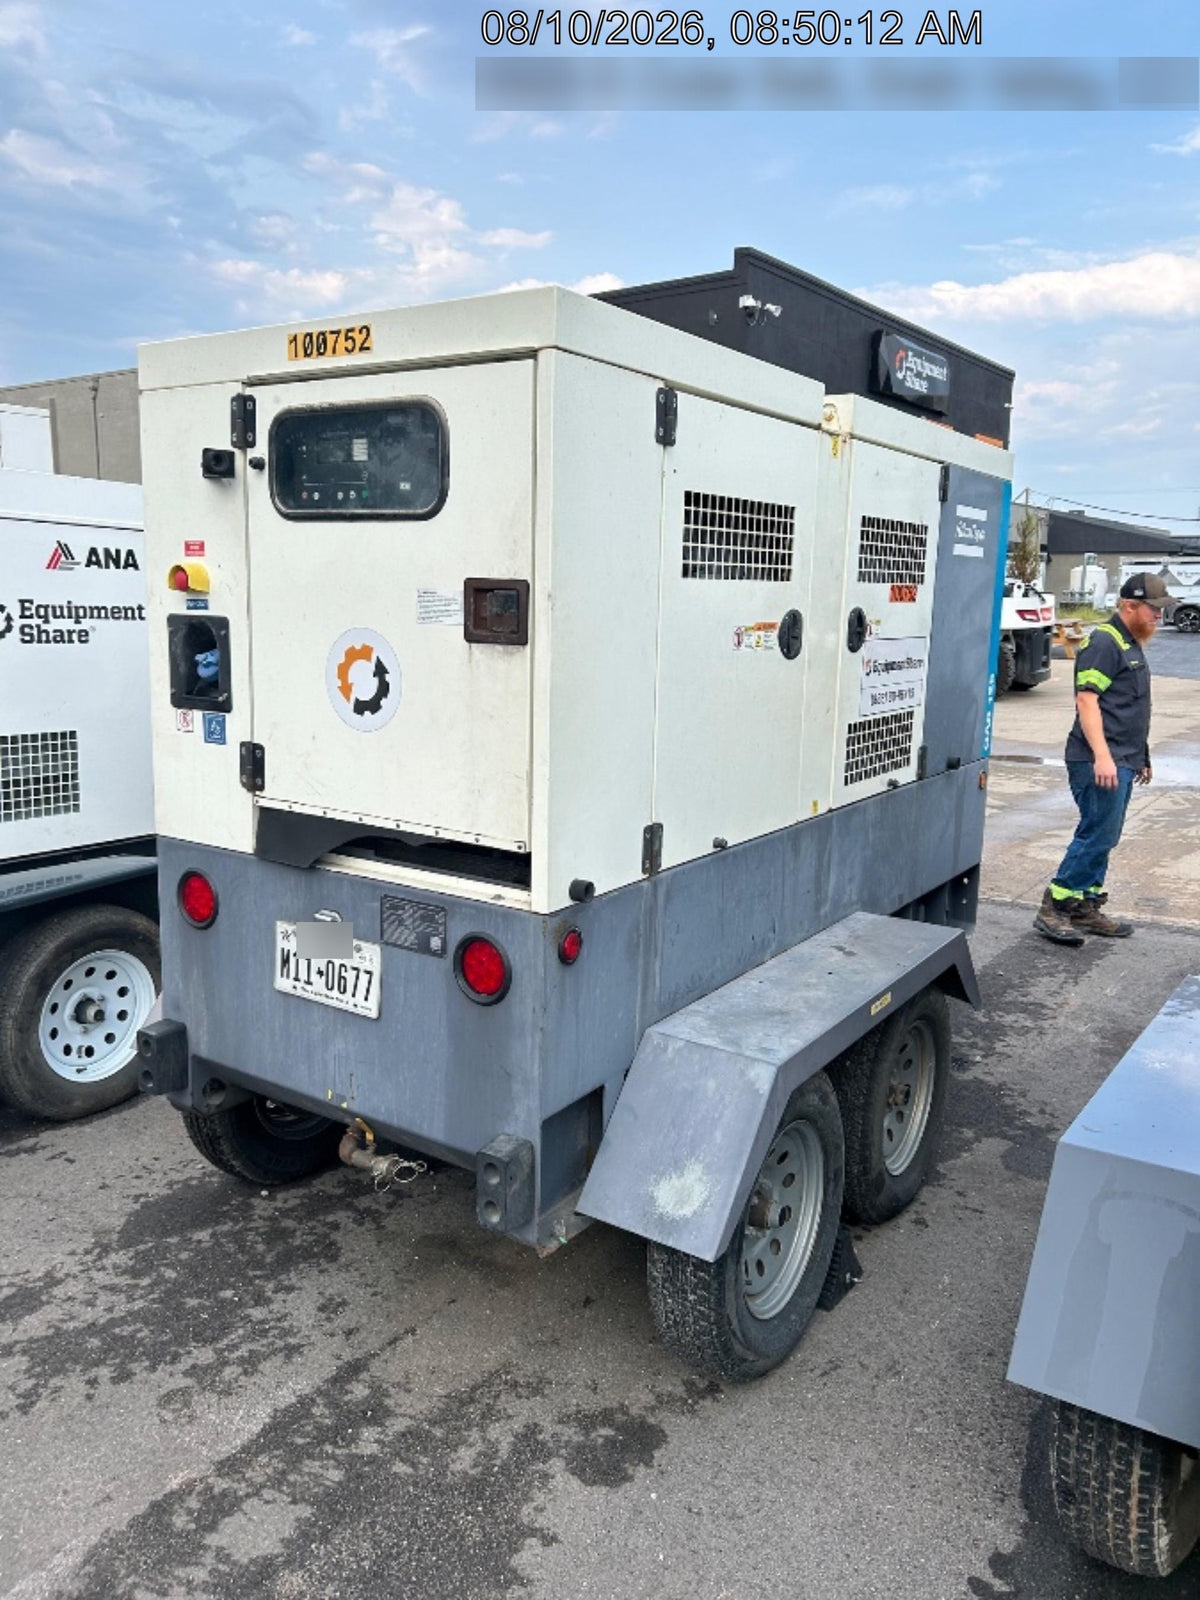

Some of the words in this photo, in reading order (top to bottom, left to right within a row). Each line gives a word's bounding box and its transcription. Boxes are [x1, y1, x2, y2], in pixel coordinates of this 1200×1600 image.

[289, 325, 371, 358] 100752
[85, 547, 140, 571] ANA
[18, 598, 146, 624] Equipment
